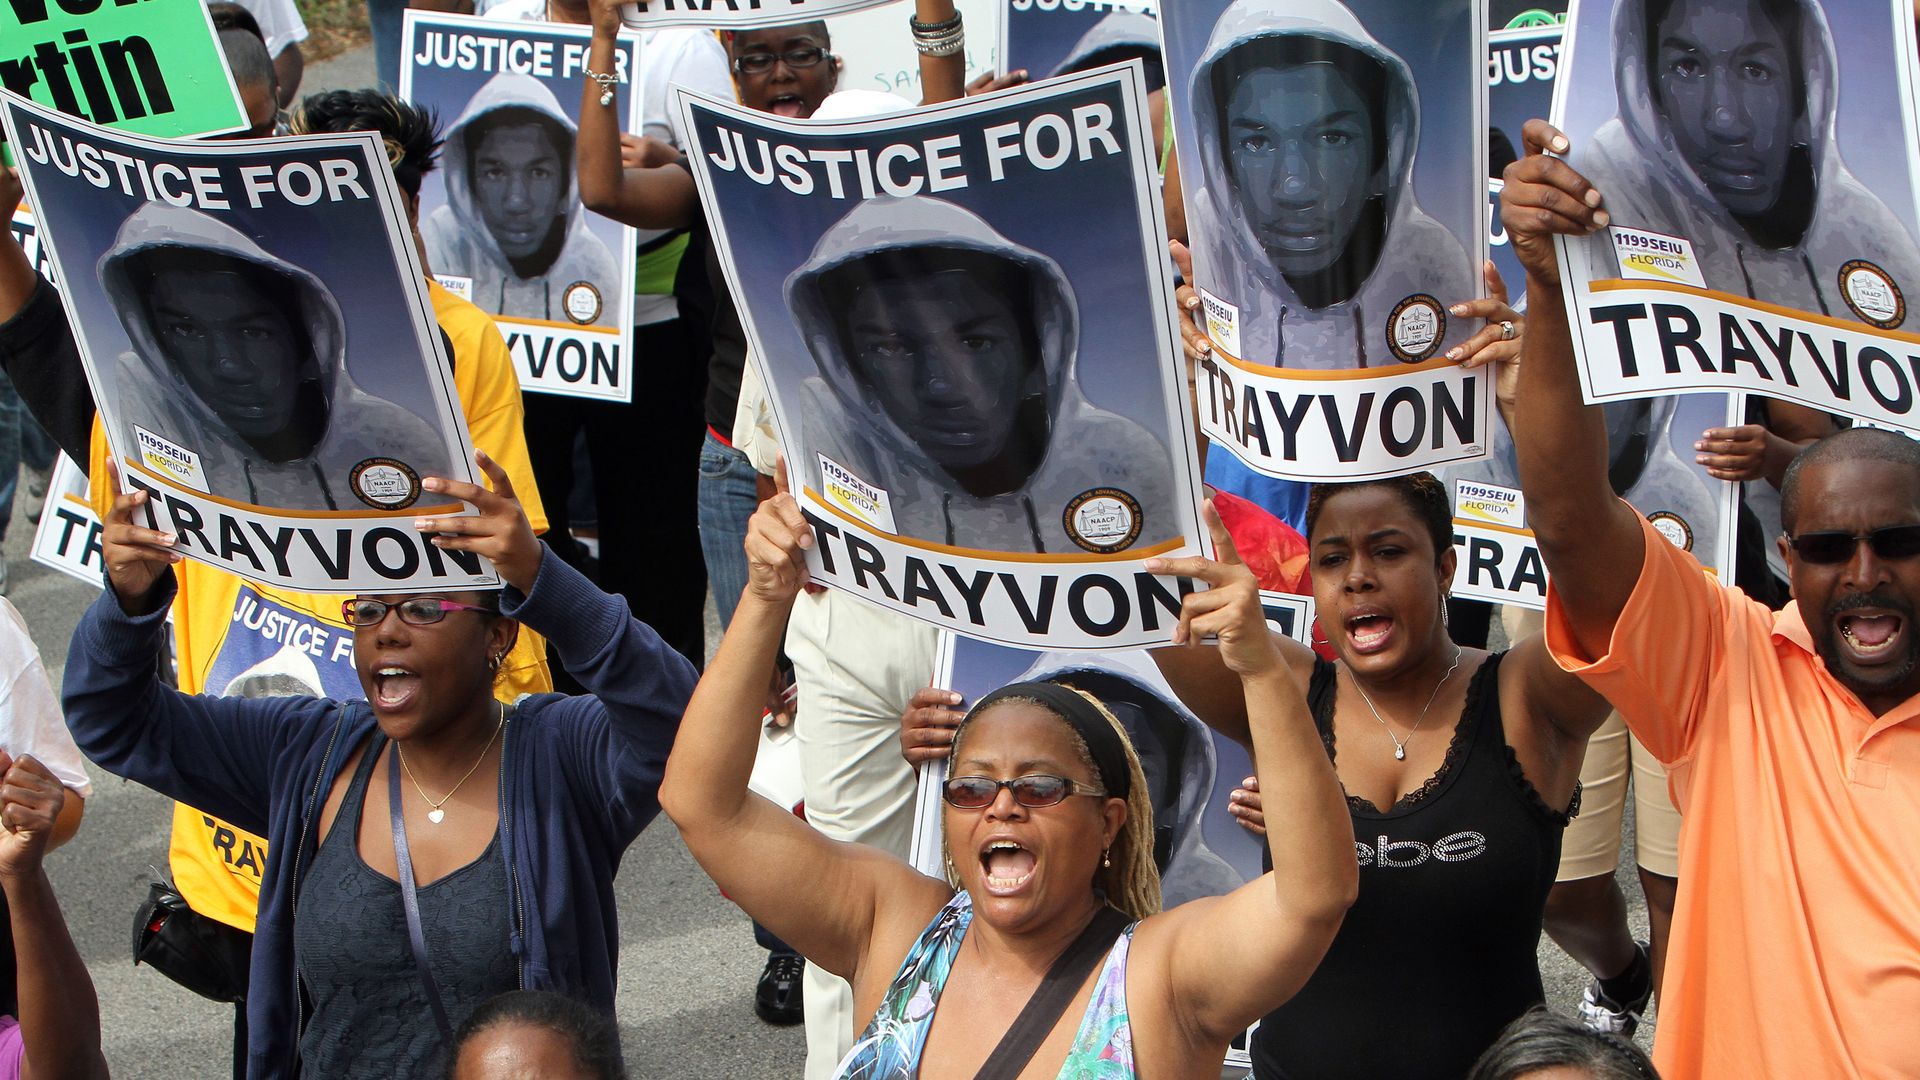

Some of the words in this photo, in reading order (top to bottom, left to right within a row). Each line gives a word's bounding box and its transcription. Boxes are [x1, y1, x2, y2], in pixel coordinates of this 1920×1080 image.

[415, 31, 554, 78] JUSTICE
[1488, 44, 1561, 87] JUS
[26, 123, 231, 210] JUSTICE
[239, 158, 370, 209] FOR
[709, 126, 968, 200] JUSTICE
[984, 102, 1122, 182] FOR
[1614, 232, 1683, 255] 1199SEIU
[1630, 253, 1685, 271] FLORIDA
[1407, 323, 1426, 332] NAACP
[1589, 302, 1920, 415] TRAYVO
[1202, 360, 1476, 463] TRAYVON
[138, 432, 192, 464] 1199SEIU
[148, 450, 191, 477] FLORIDA
[822, 461, 878, 502] 1199SEIU
[831, 482, 877, 515] FLORIDA
[1459, 485, 1516, 503] 1199SEIU
[127, 473, 485, 580] TRAYVON
[1090, 516, 1116, 525] NAACP
[1465, 500, 1510, 515] FLORIDA
[801, 507, 1194, 638] TRAYVON
[233, 595, 330, 658] JUSTICE
